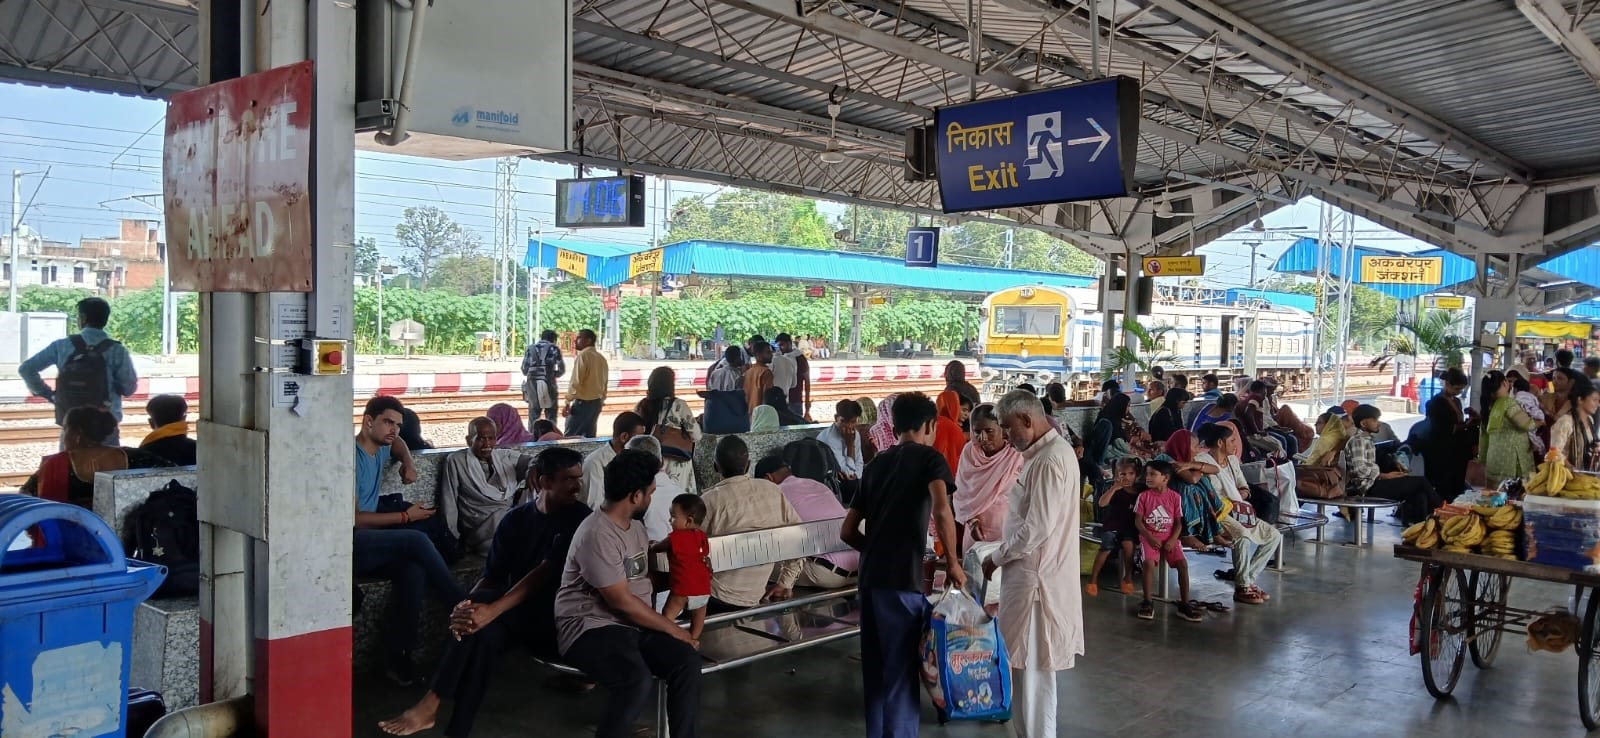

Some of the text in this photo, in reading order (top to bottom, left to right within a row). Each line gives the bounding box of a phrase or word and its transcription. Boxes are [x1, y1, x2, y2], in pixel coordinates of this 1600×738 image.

[476, 110, 519, 124] manifold
[946, 121, 1014, 153] निकास
[968, 161, 1019, 192] Exit
[187, 202, 274, 261] AHEAD
[913, 235, 924, 259] 1
[1368, 258, 1435, 272] अकबरपुर
